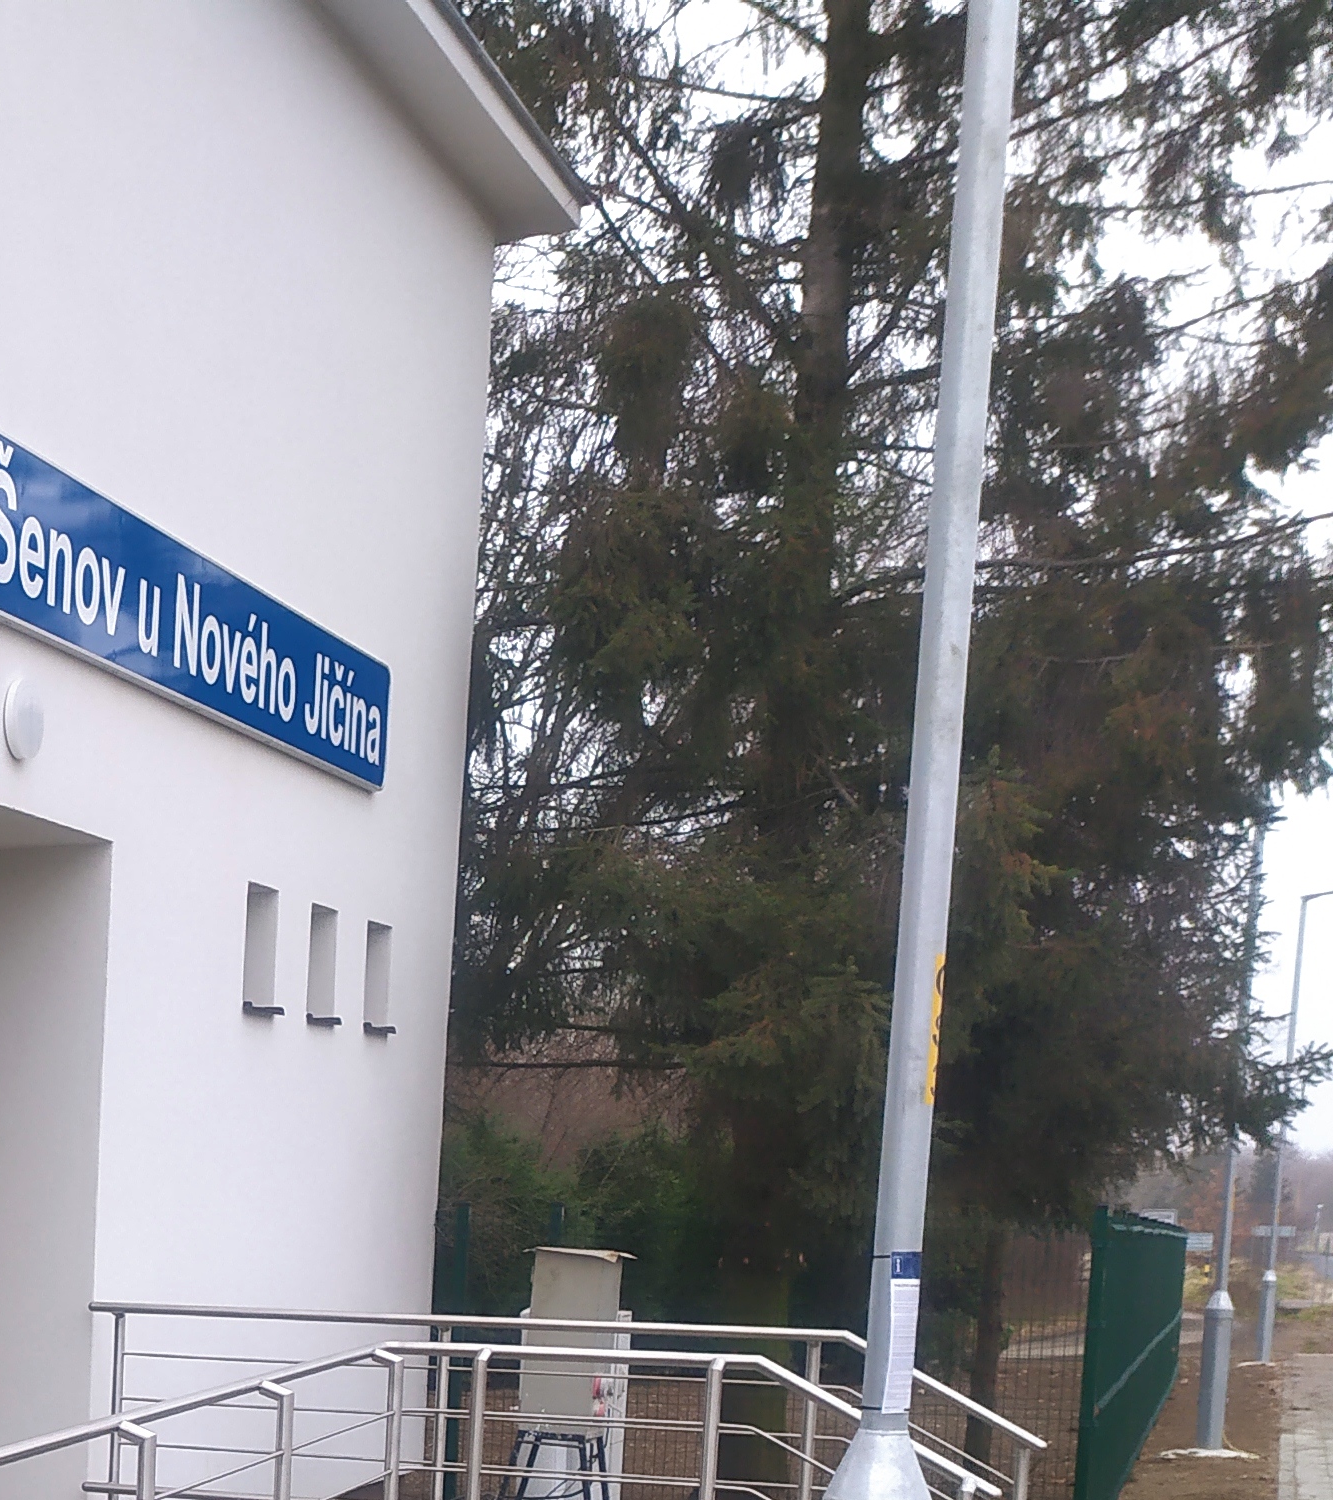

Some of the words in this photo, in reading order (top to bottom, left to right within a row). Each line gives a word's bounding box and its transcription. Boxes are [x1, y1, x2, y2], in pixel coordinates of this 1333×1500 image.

[138, 577, 161, 657] u
[173, 572, 296, 724] Nového
[304, 652, 382, 767] Jičína
